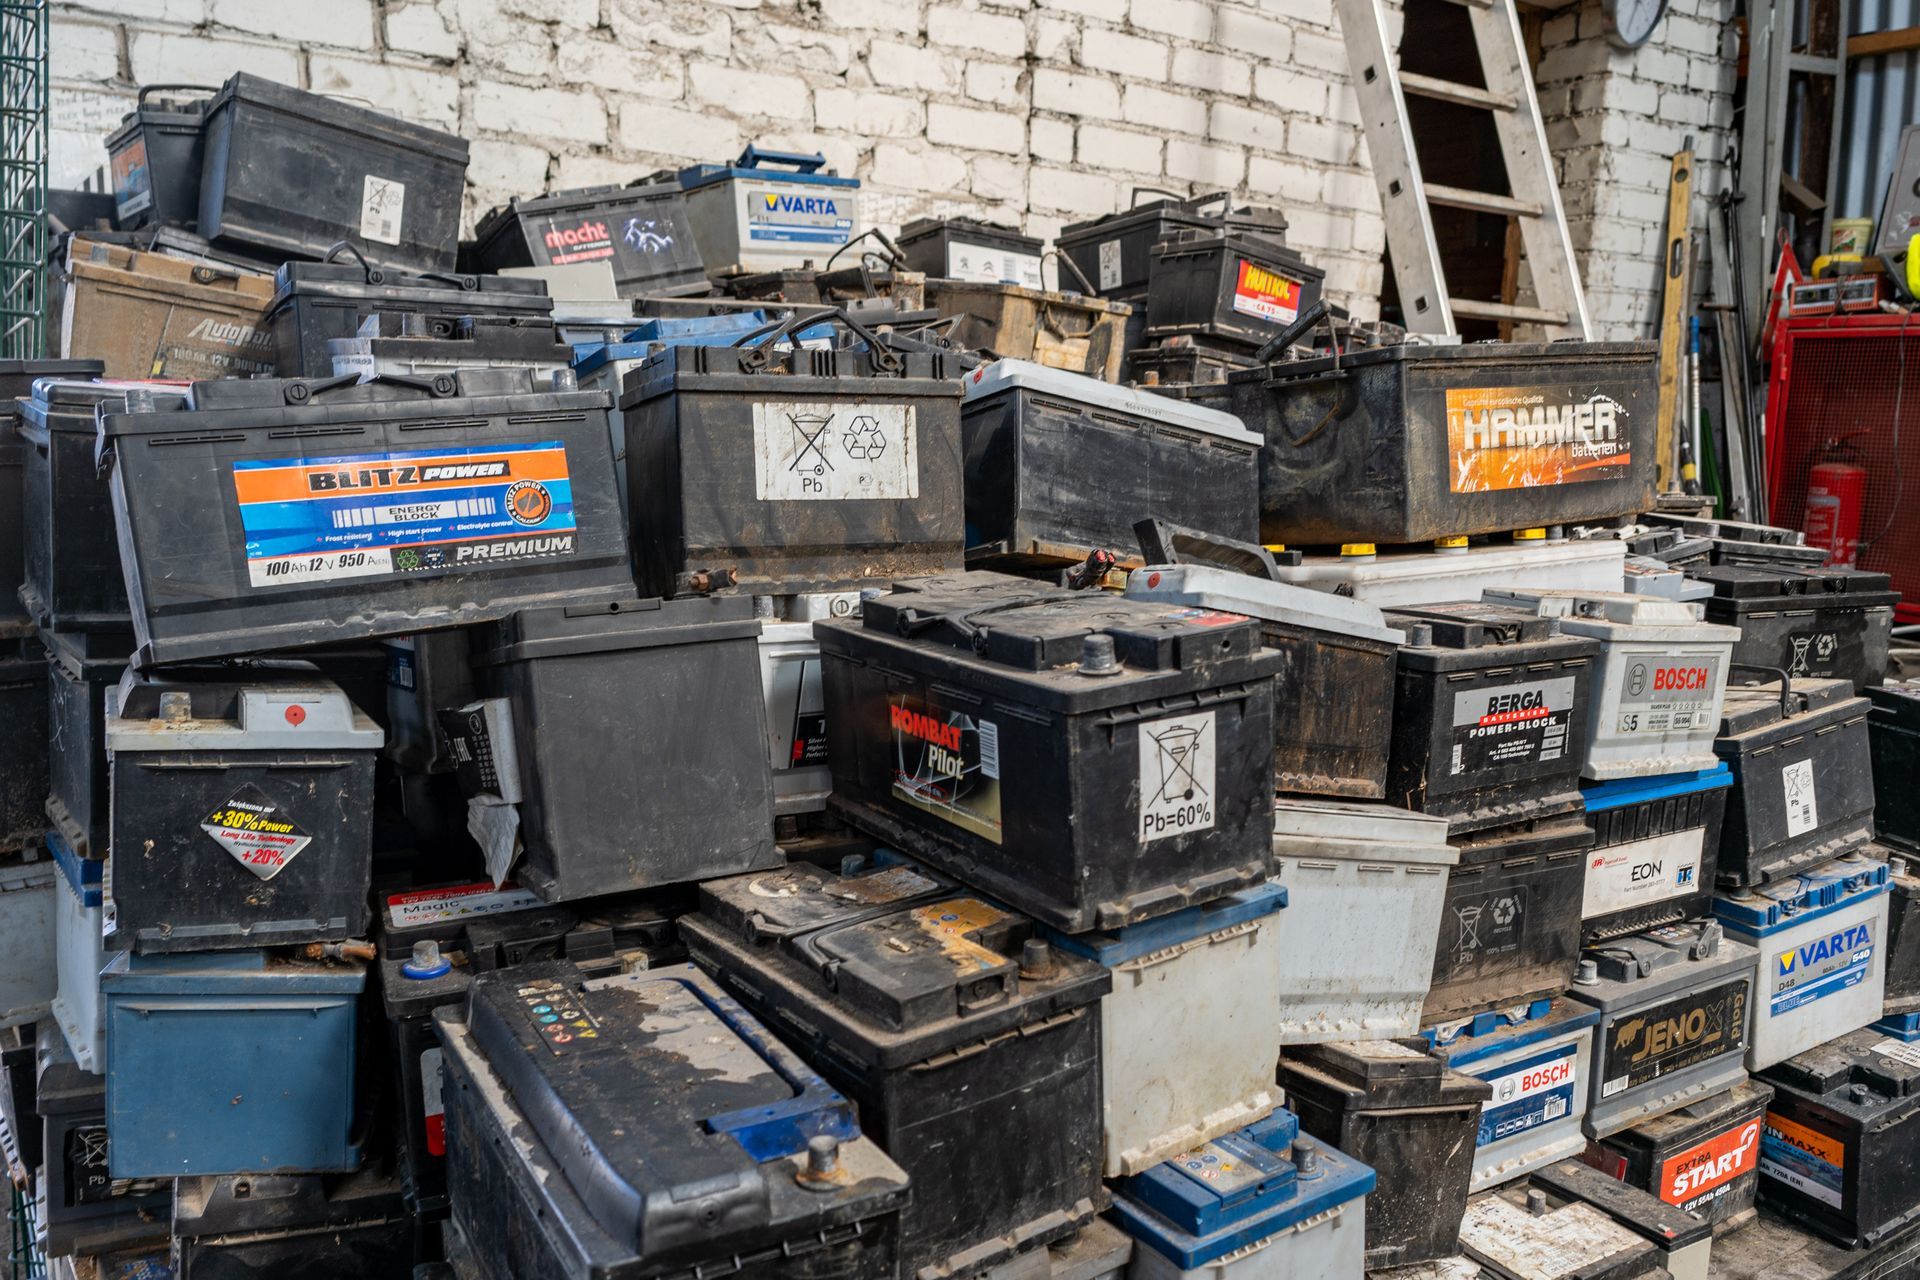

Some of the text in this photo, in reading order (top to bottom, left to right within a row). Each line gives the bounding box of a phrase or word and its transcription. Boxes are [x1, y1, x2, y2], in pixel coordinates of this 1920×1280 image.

[780, 195, 837, 216] VARTA
[545, 220, 609, 248] macht
[211, 354, 230, 367] 12V
[1463, 402, 1617, 450] HAMMER
[1572, 441, 1617, 458] batterien
[308, 465, 420, 492] BLITZ
[423, 462, 506, 481] POWER
[514, 480, 542, 492] POWER
[802, 478, 823, 493] Pb
[389, 503, 441, 516] ENERGY
[394, 511, 439, 522] BLOCK
[325, 519, 514, 543] Frost resistant High start power Electrolyte control
[456, 536, 572, 561] PREMIUM
[338, 552, 365, 568] 950
[1654, 666, 1708, 691] BOSCH
[1487, 689, 1544, 716] BERGA
[1483, 709, 1546, 723] BATTERIEN
[1622, 714, 1639, 732] S5
[891, 704, 961, 752] ROMBAT
[1469, 716, 1557, 738] POWER-BLOCK
[928, 744, 965, 780] Pilot
[1790, 799, 1800, 807] Pb
[258, 820, 294, 834] Power
[1144, 801, 1211, 835] Pb=60%
[221, 829, 297, 845] Long Life Technology
[1630, 859, 1663, 881] EON
[403, 900, 460, 914] Magic
[1799, 923, 1870, 968] VARTA
[1852, 949, 1871, 963] 540
[1460, 951, 1474, 964] Pb
[1778, 978, 1796, 992] D48
[1731, 993, 1745, 1040] Gold
[1631, 999, 1725, 1062] JENOX
[1522, 1062, 1569, 1092] BOSCH
[1672, 1144, 1748, 1197] START
[1676, 1151, 1712, 1175] EXTRA
[88, 1176, 106, 1186] Pb
[1772, 1167, 1789, 1180] 720A
[1789, 1175, 1804, 1187] (EN)
[1684, 1183, 1731, 1212] 12V 55Ah 450A
